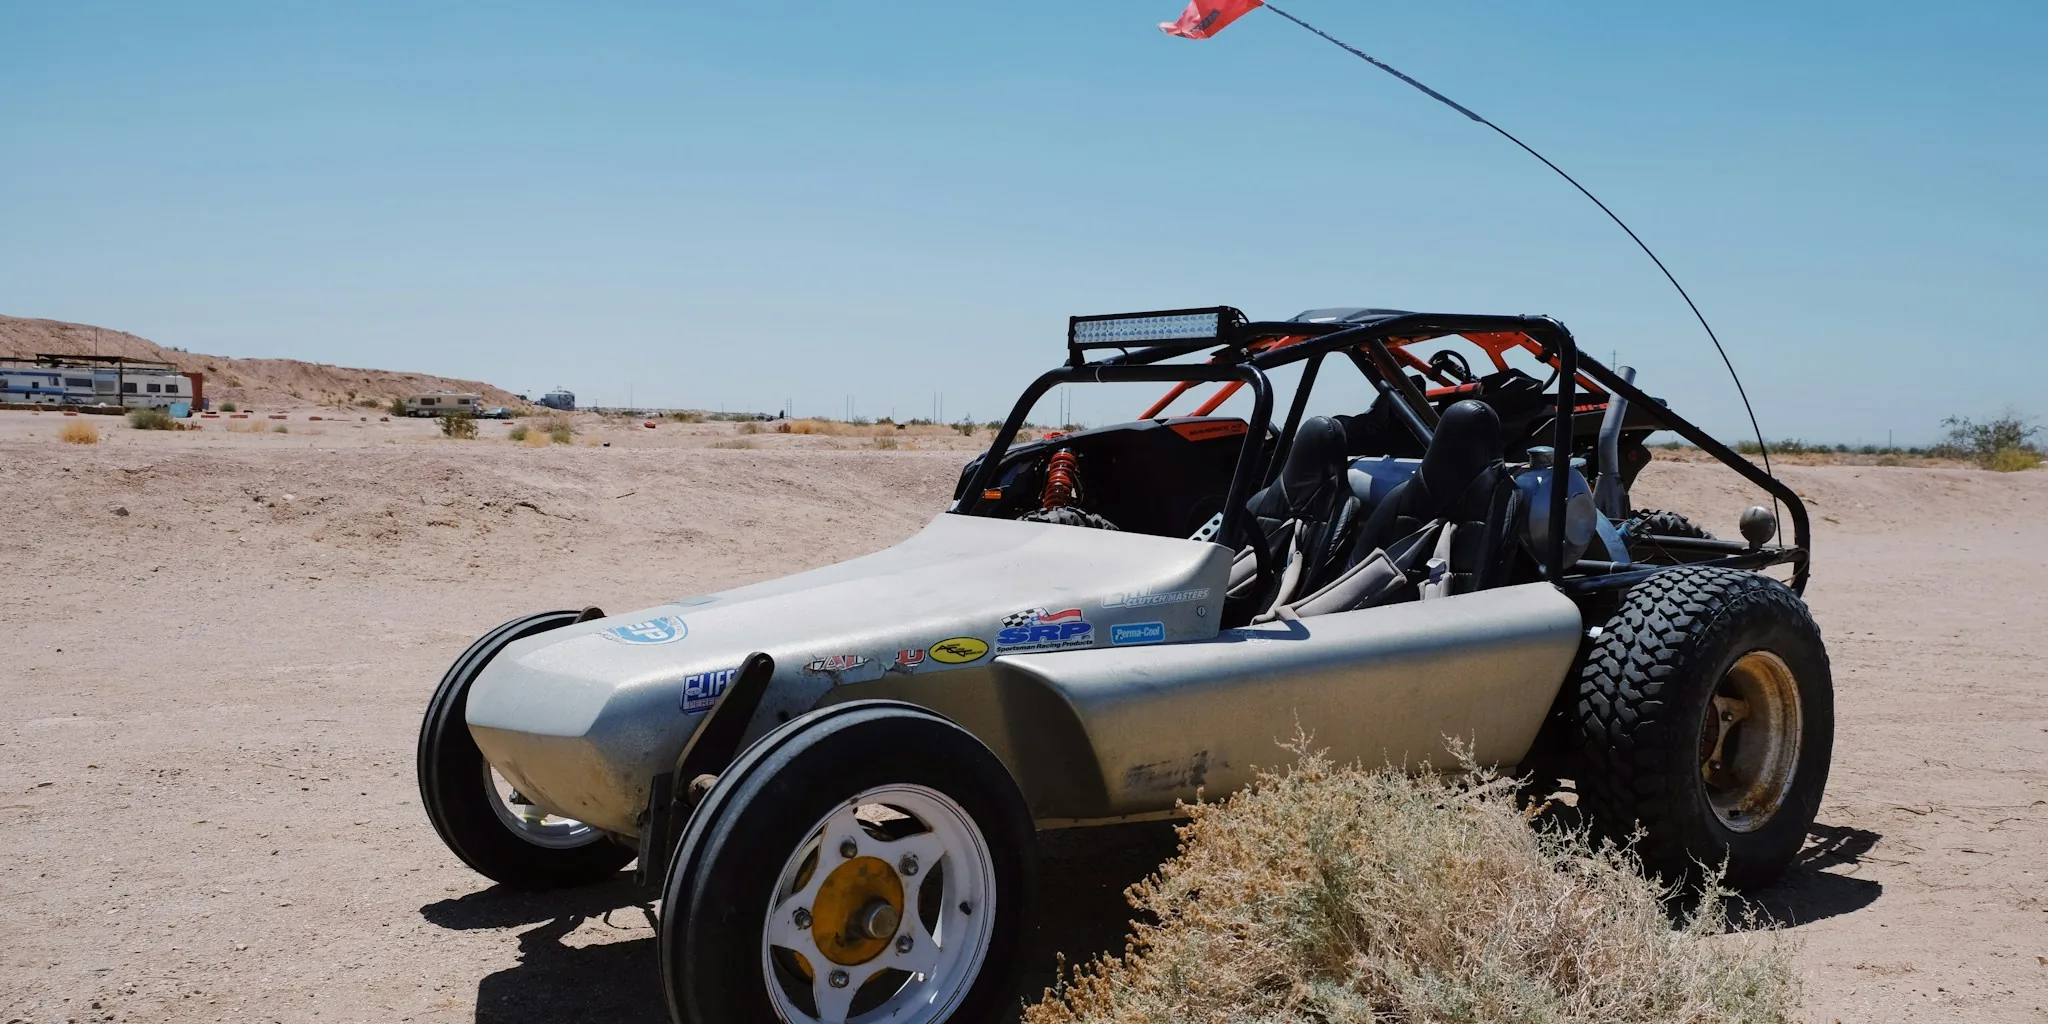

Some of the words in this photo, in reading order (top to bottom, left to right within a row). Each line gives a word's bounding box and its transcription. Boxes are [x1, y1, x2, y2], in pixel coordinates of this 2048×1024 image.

[1126, 594, 1166, 606] CLUTCH
[1168, 590, 1209, 601] MASTERS
[996, 621, 1093, 645] SRP
[1115, 626, 1161, 640] Perma-Cool
[997, 644, 1035, 652] Sportsman
[1062, 639, 1093, 647] Products
